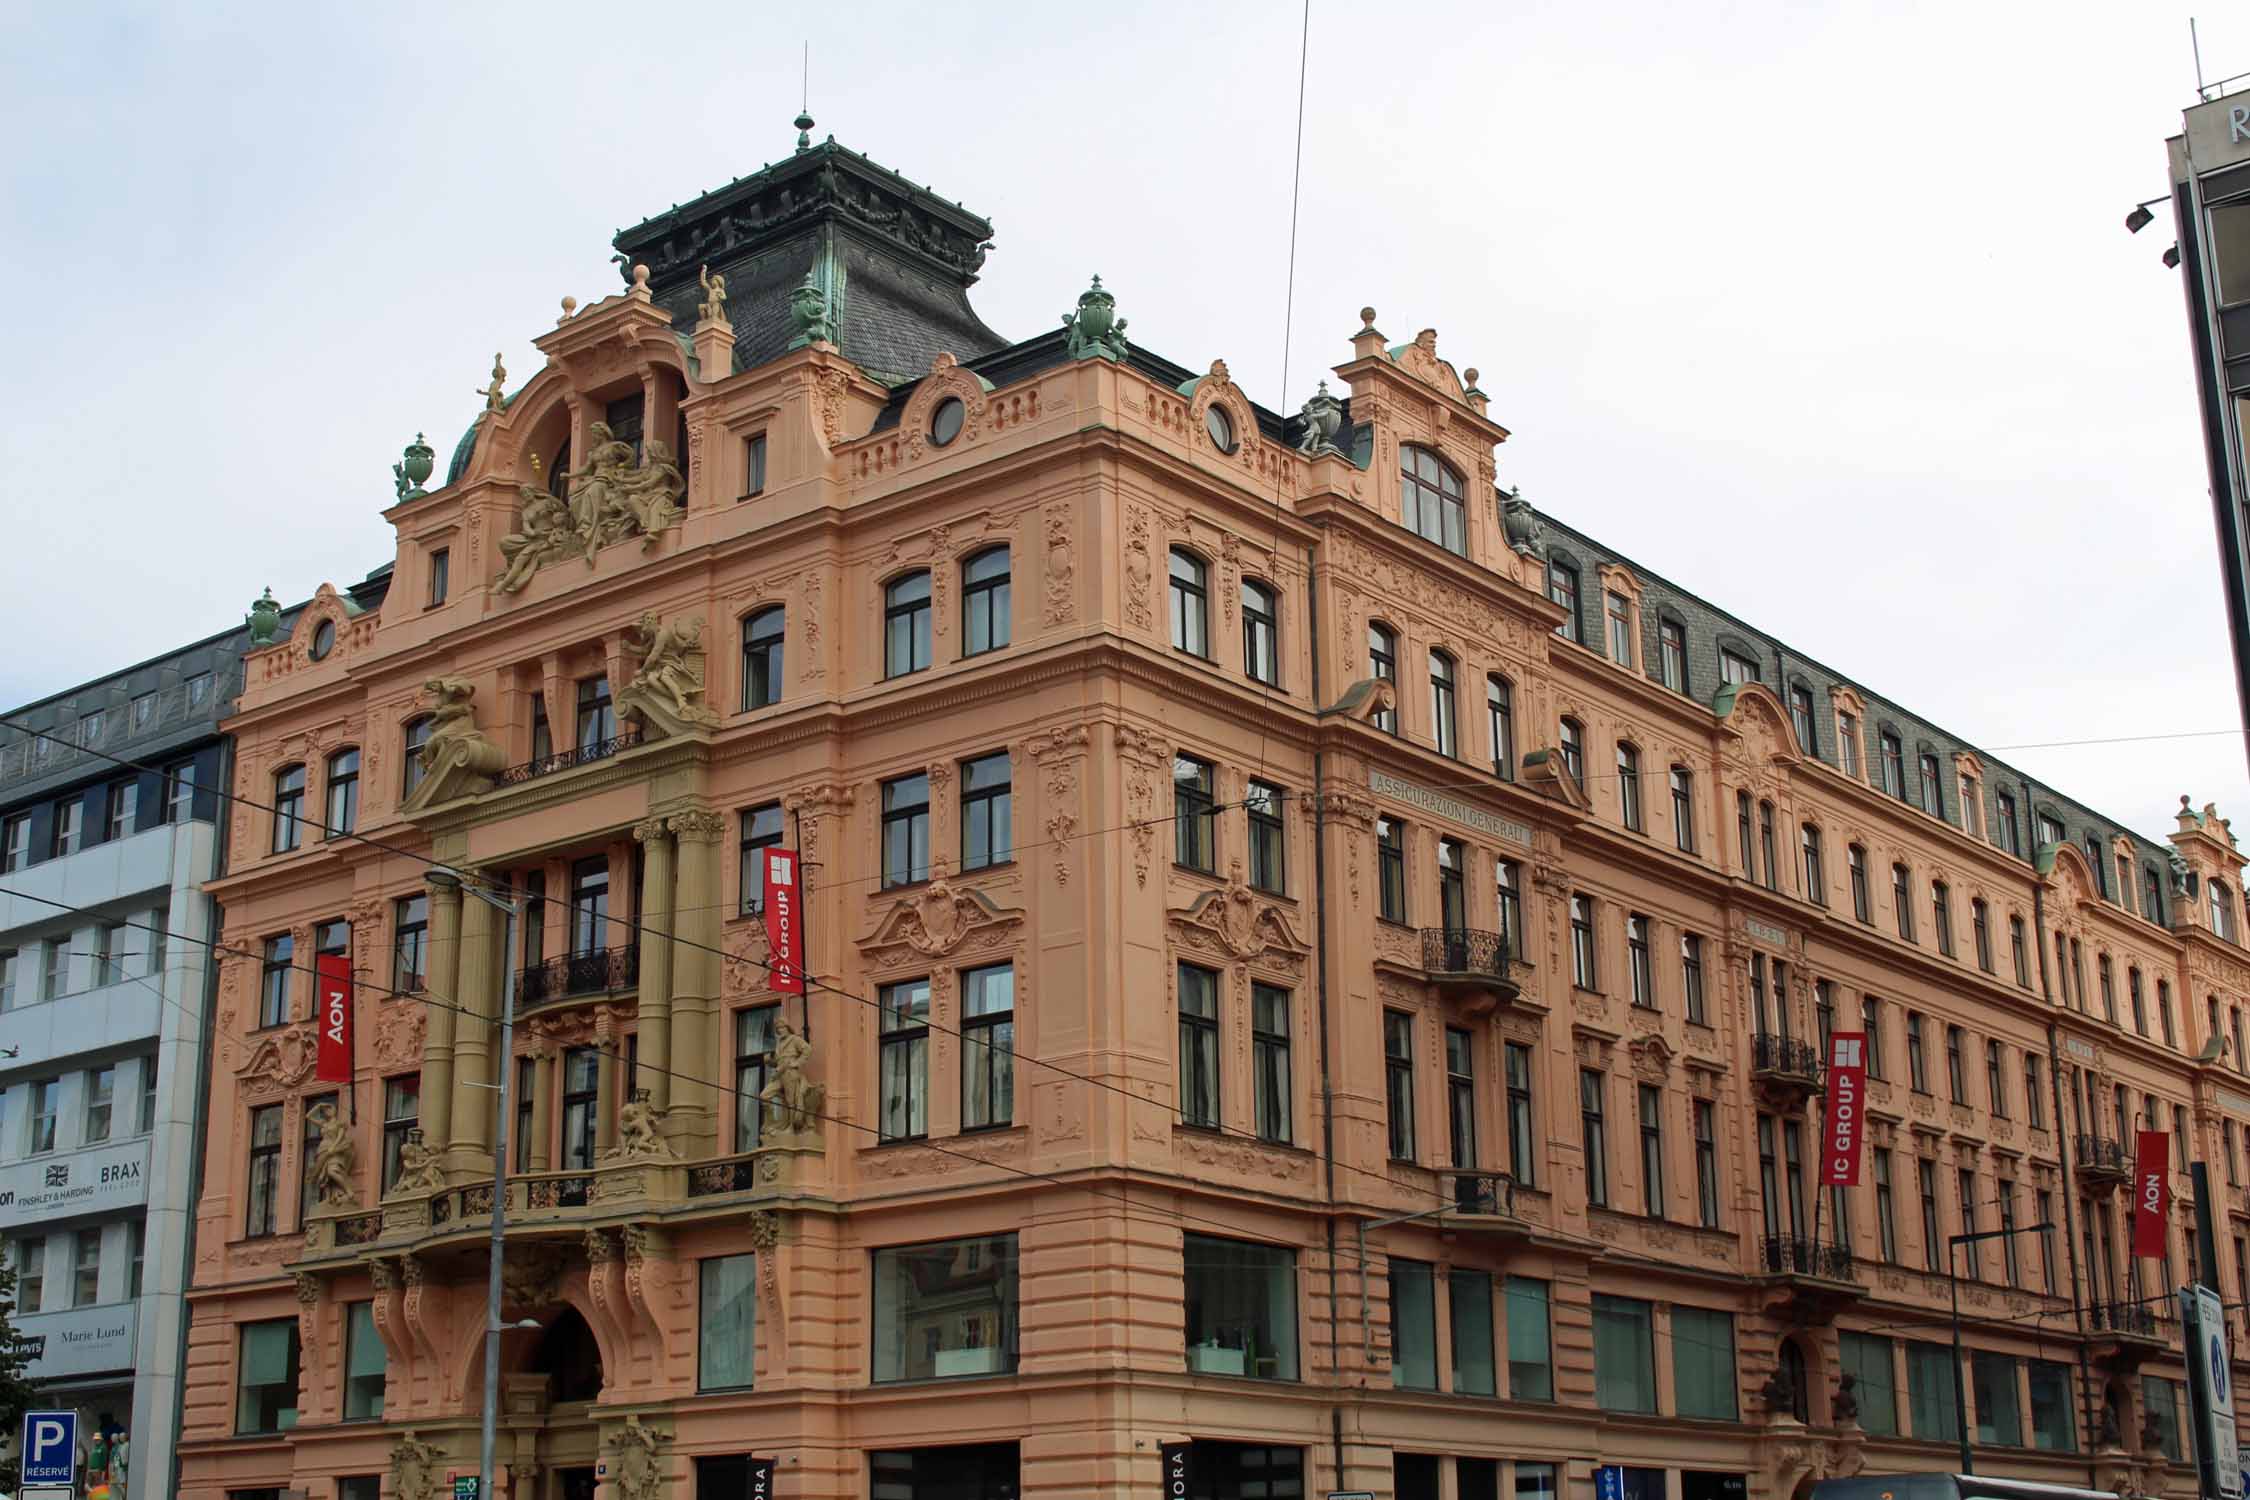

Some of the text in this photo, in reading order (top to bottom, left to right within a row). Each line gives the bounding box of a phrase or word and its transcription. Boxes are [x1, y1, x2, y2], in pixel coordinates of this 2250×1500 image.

[777, 890, 791, 960] GROUP
[327, 991, 344, 1045] AON
[1833, 1074, 1854, 1180] IC GROUP
[60, 1185, 95, 1200] HARDING
[101, 1161, 140, 1184] BRAX
[2144, 1174, 2160, 1214] AON
[62, 1324, 126, 1343] Marie Lund
[34, 1421, 65, 1462] P
